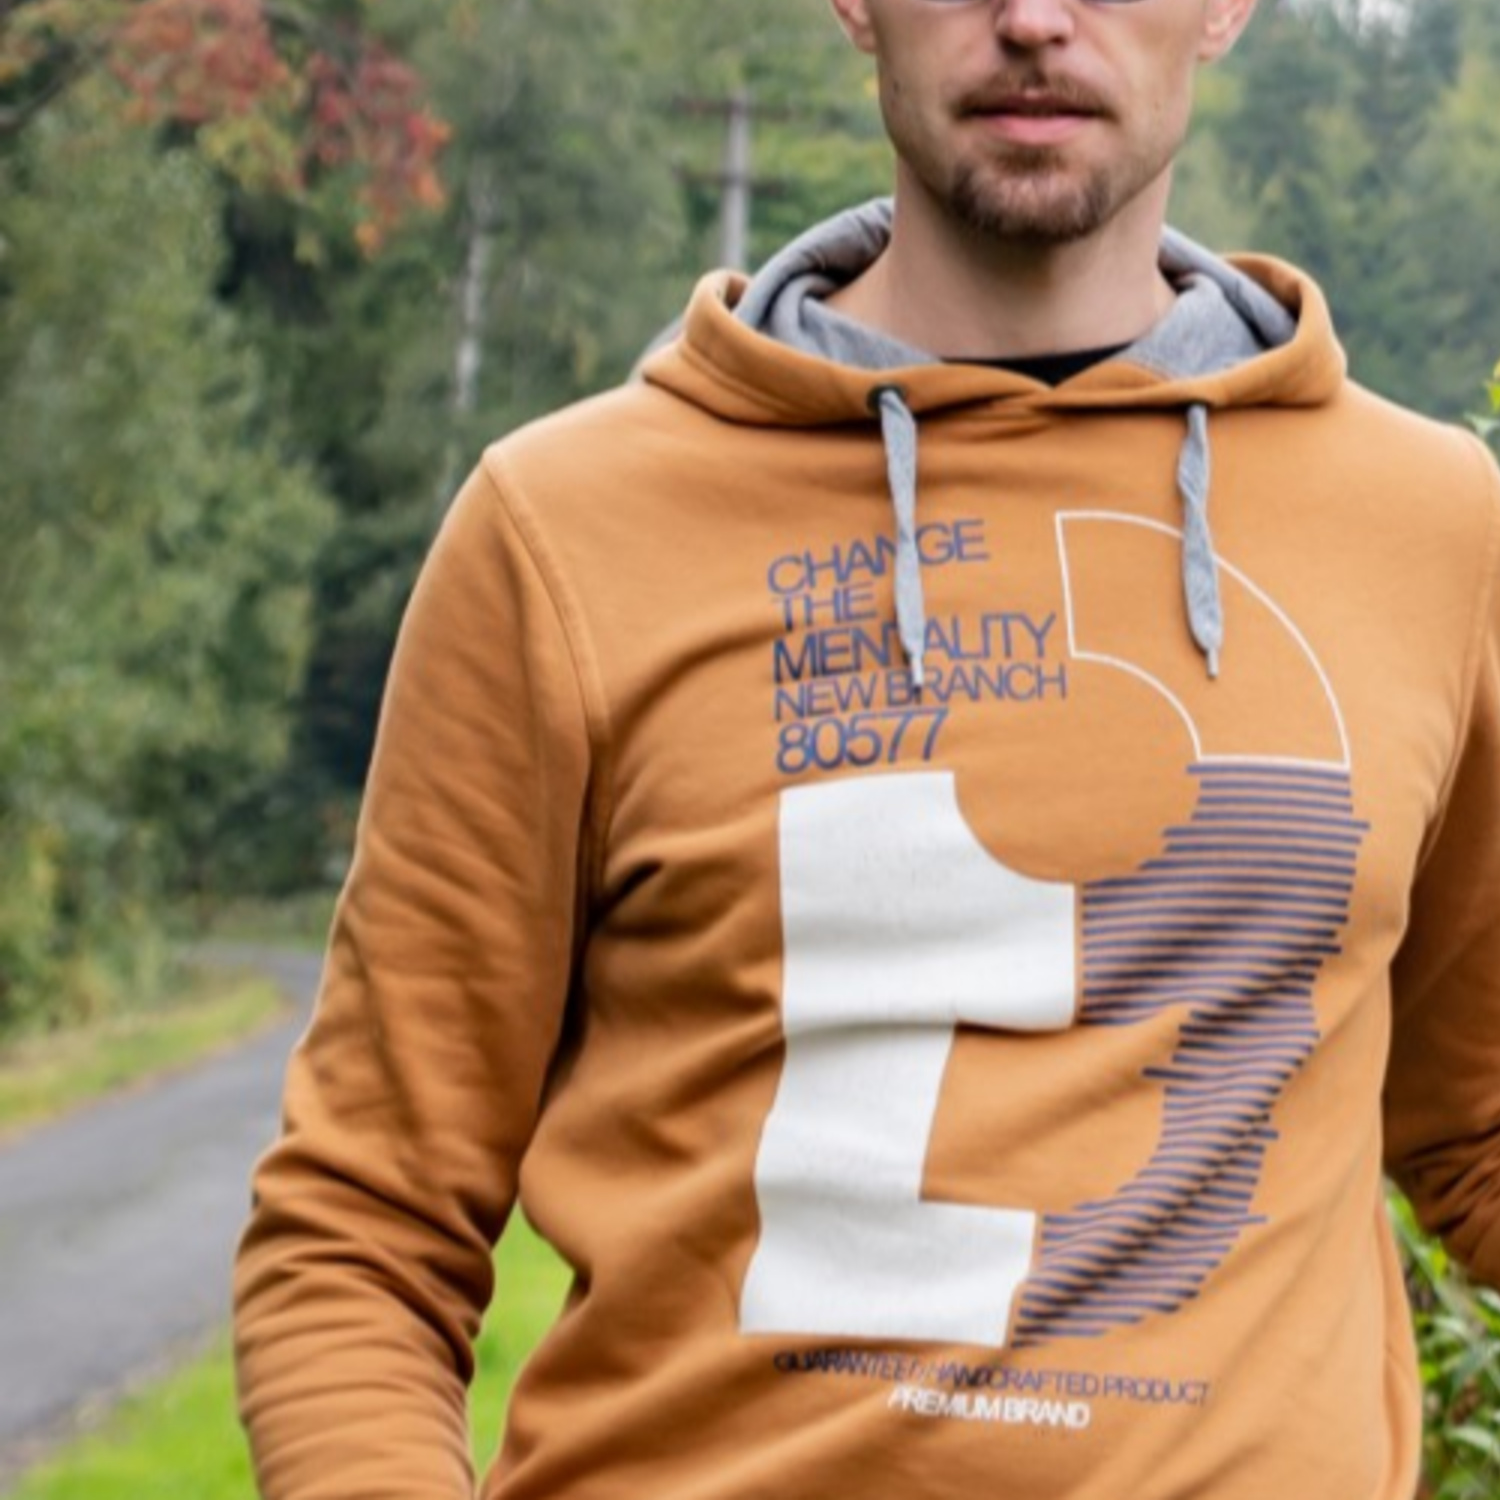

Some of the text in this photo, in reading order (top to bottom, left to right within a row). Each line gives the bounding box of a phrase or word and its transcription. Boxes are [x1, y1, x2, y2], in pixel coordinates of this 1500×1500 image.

[772, 581, 877, 632] THE
[774, 663, 1067, 721] NEW BRANCH
[775, 707, 949, 775] 80577
[887, 1383, 1091, 1429] PREMIUM BRAND
[1102, 1373, 1209, 1407] PRODUCT
